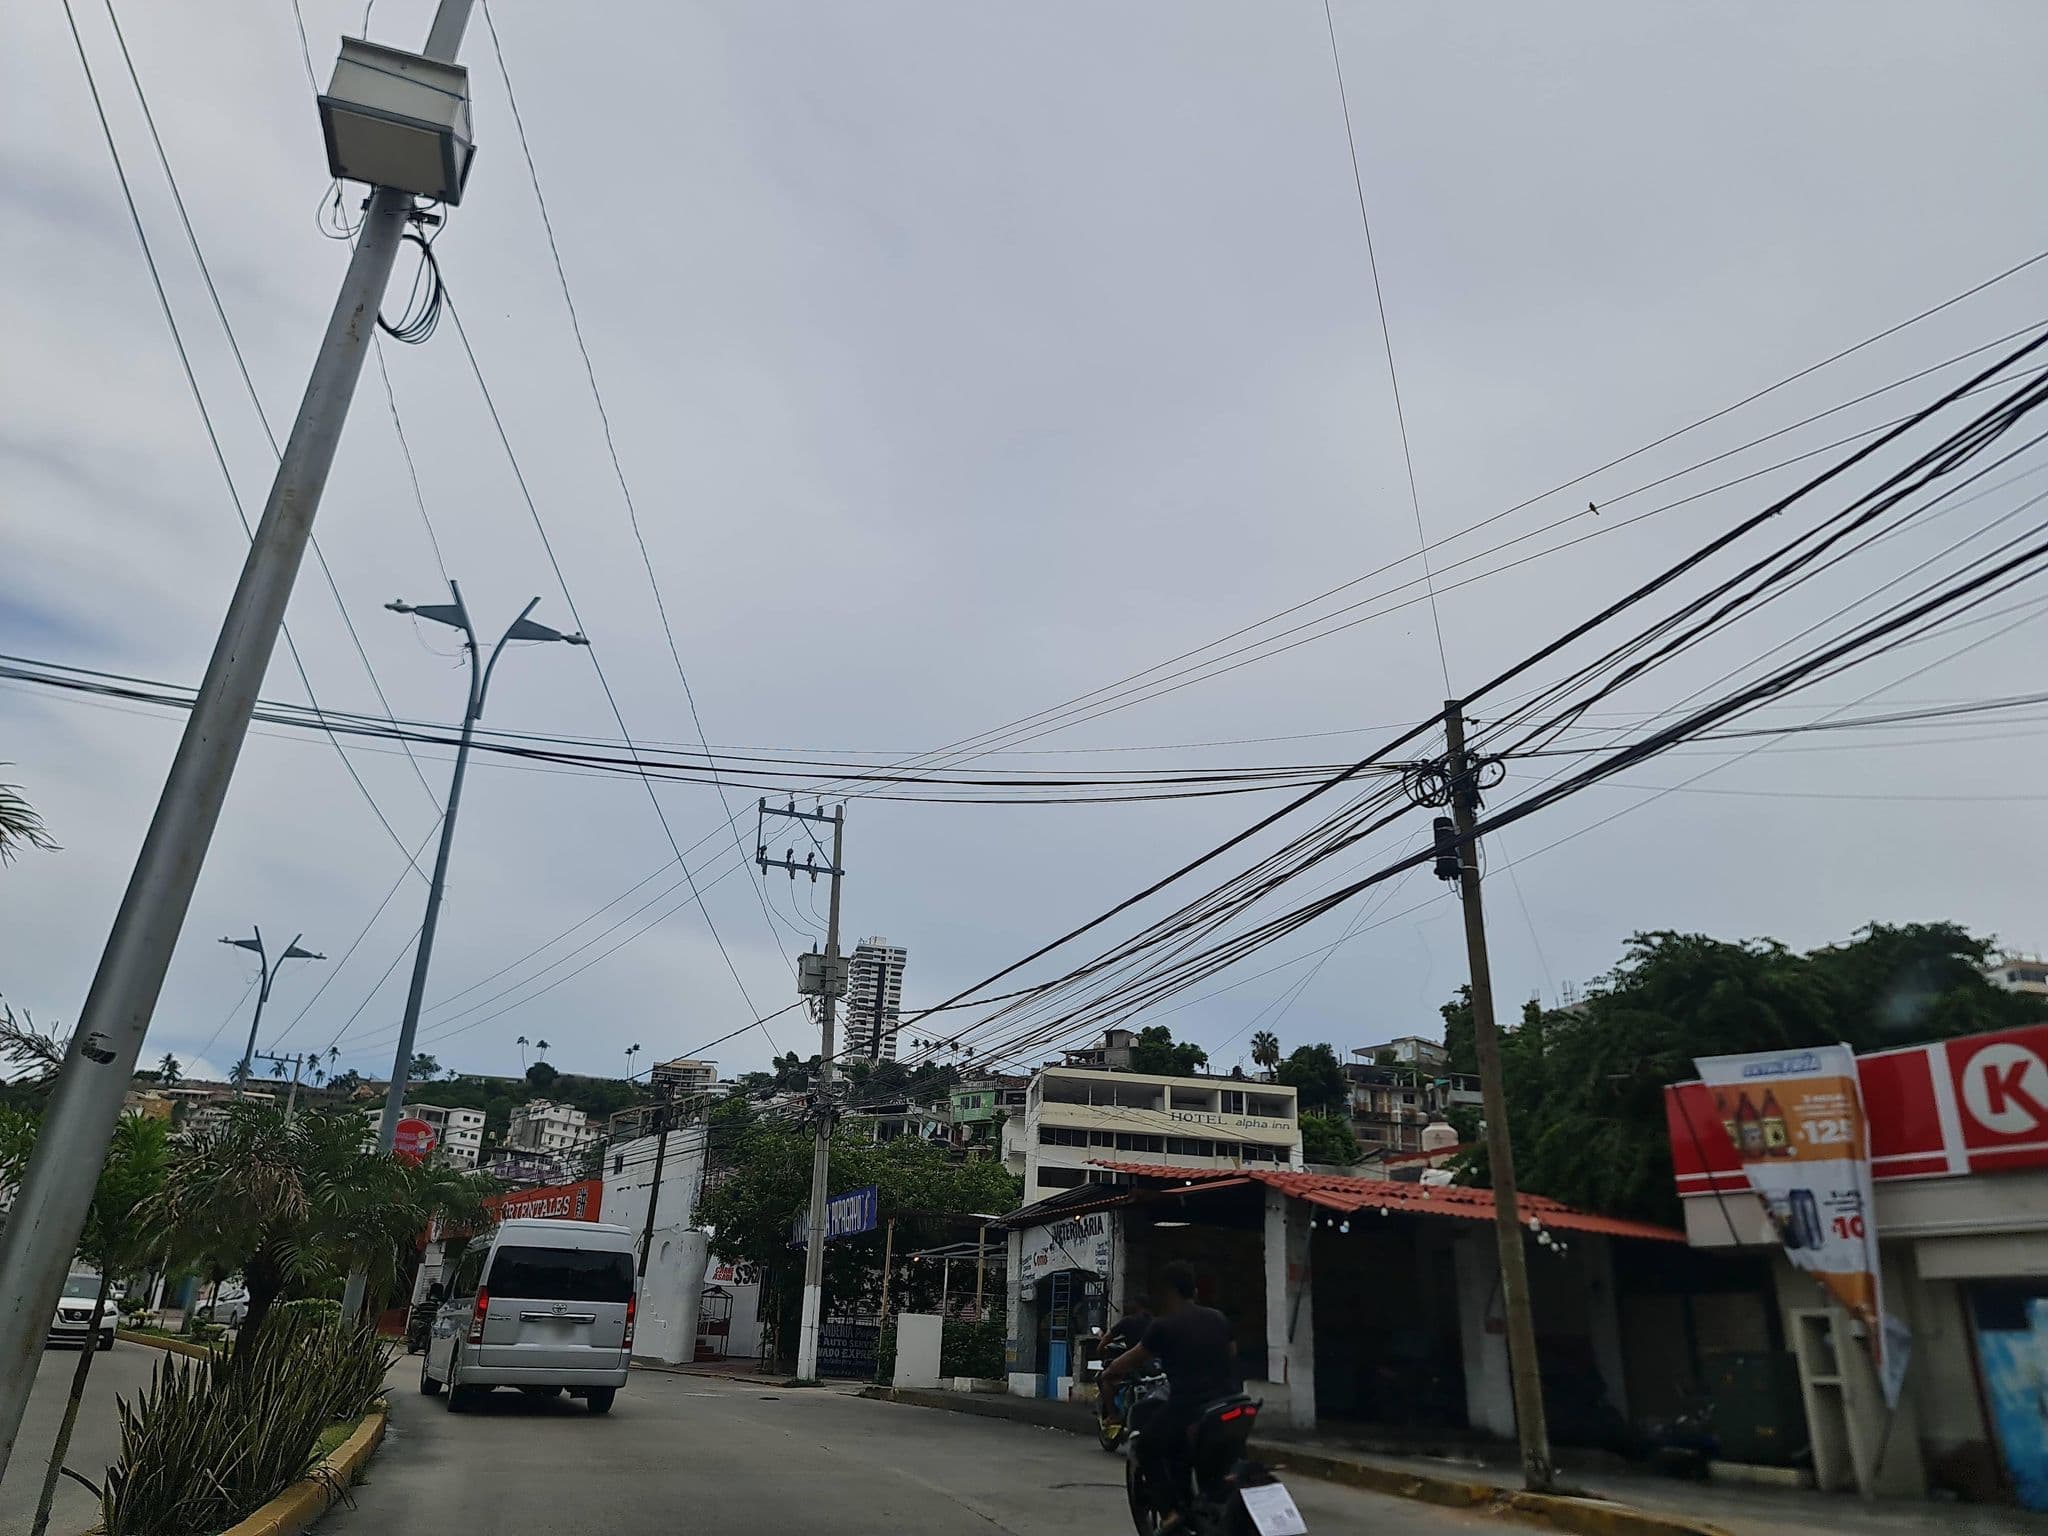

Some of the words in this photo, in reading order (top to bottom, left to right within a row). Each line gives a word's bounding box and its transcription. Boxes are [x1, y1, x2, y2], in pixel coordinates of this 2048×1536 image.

[1983, 1061, 2048, 1122] K
[1171, 1112, 1228, 1125] HOTEL
[1235, 1118, 1268, 1129] alpha
[1272, 1120, 1290, 1130] inn
